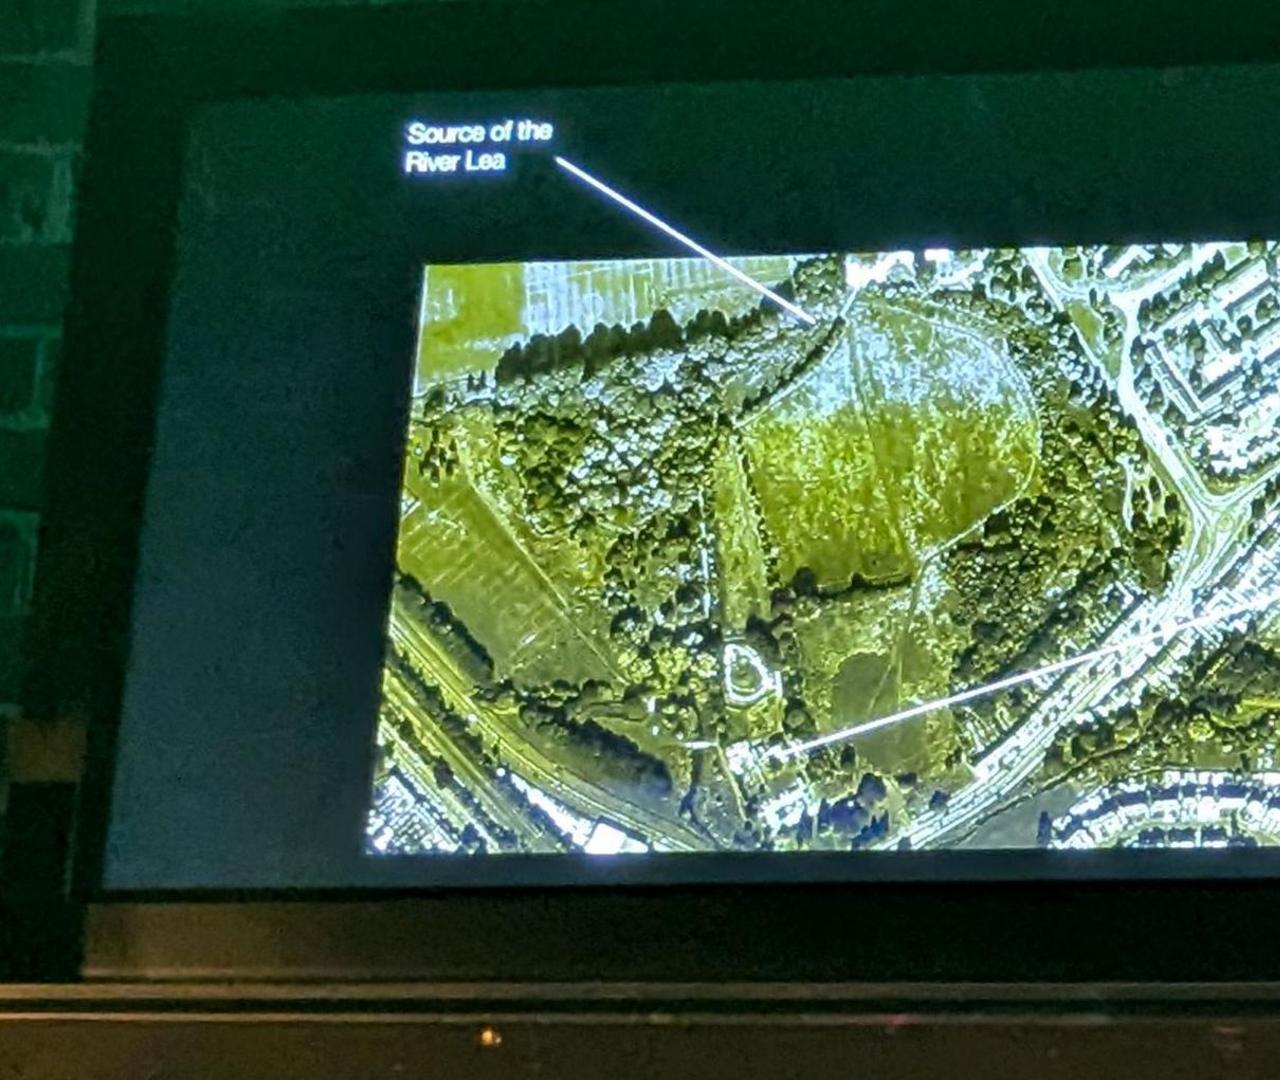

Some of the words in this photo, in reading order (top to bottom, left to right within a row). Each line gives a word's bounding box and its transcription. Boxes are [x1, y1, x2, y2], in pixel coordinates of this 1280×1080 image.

[407, 122, 485, 144] Source
[489, 120, 514, 142] of
[517, 119, 554, 141] the
[404, 151, 462, 173] River
[465, 150, 506, 171] Lea
